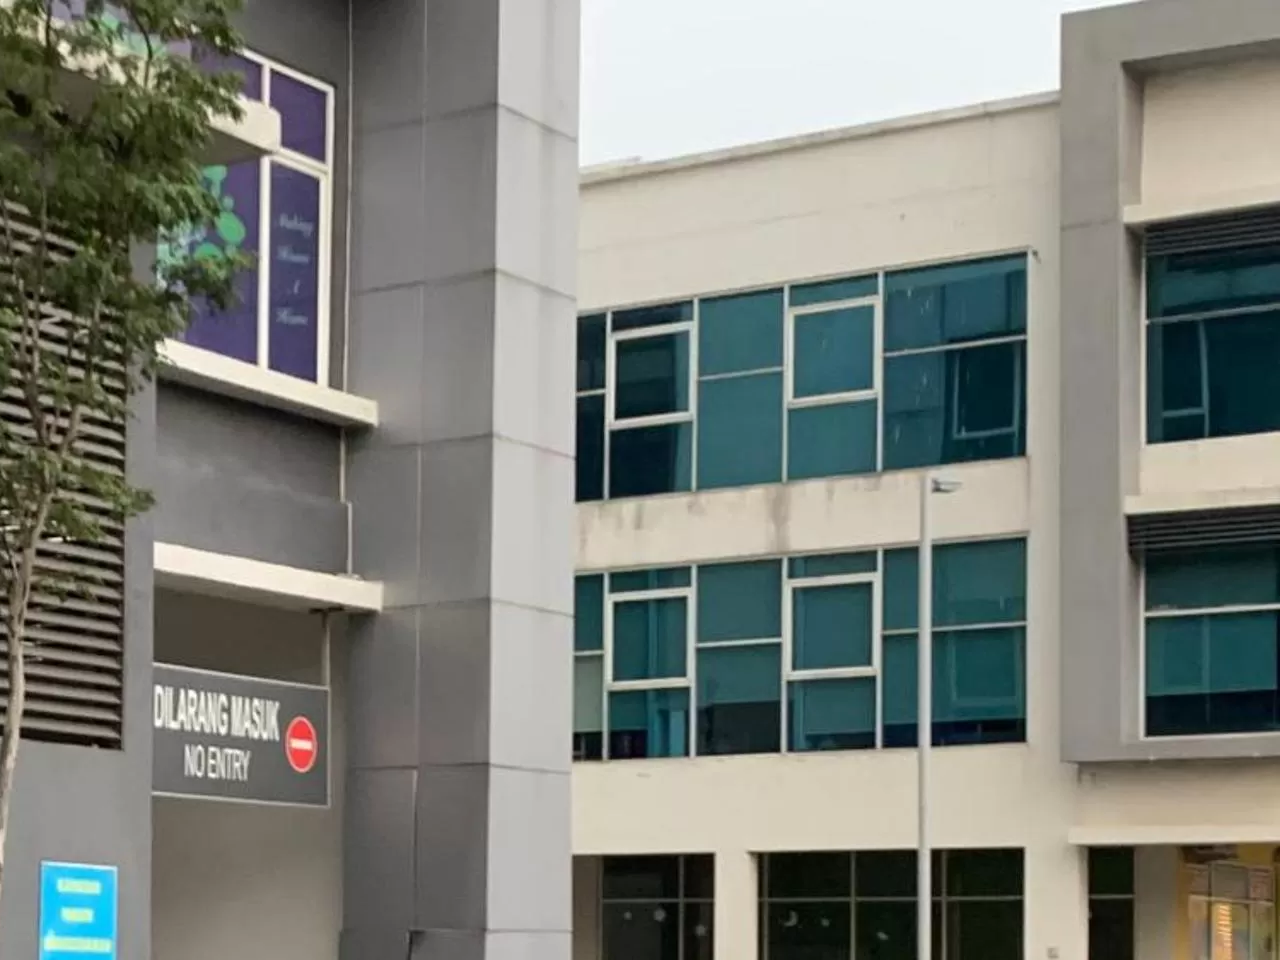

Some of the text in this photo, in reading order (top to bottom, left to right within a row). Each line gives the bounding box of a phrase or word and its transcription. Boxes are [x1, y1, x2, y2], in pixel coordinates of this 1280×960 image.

[154, 684, 280, 742] DILARANG MASUK
[184, 744, 251, 781] NO ENTRY
